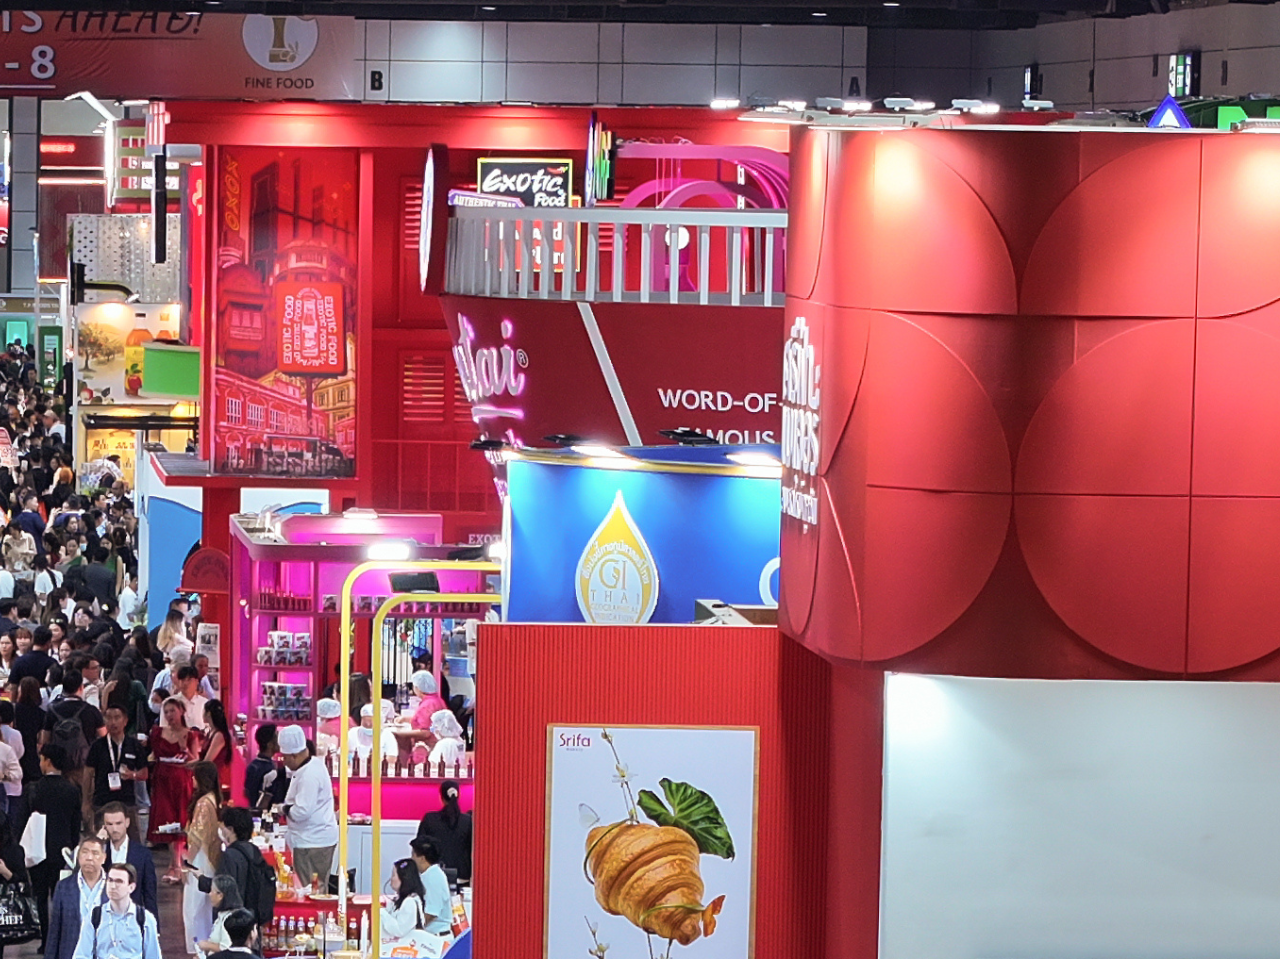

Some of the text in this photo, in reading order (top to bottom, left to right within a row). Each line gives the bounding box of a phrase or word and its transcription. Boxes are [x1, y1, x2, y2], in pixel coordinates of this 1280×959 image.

[30, 45, 55, 79] 8
[245, 77, 315, 89] FINE FOOD
[370, 70, 384, 91] B
[590, 589, 640, 605] THAI
[559, 732, 591, 747] Srifa
